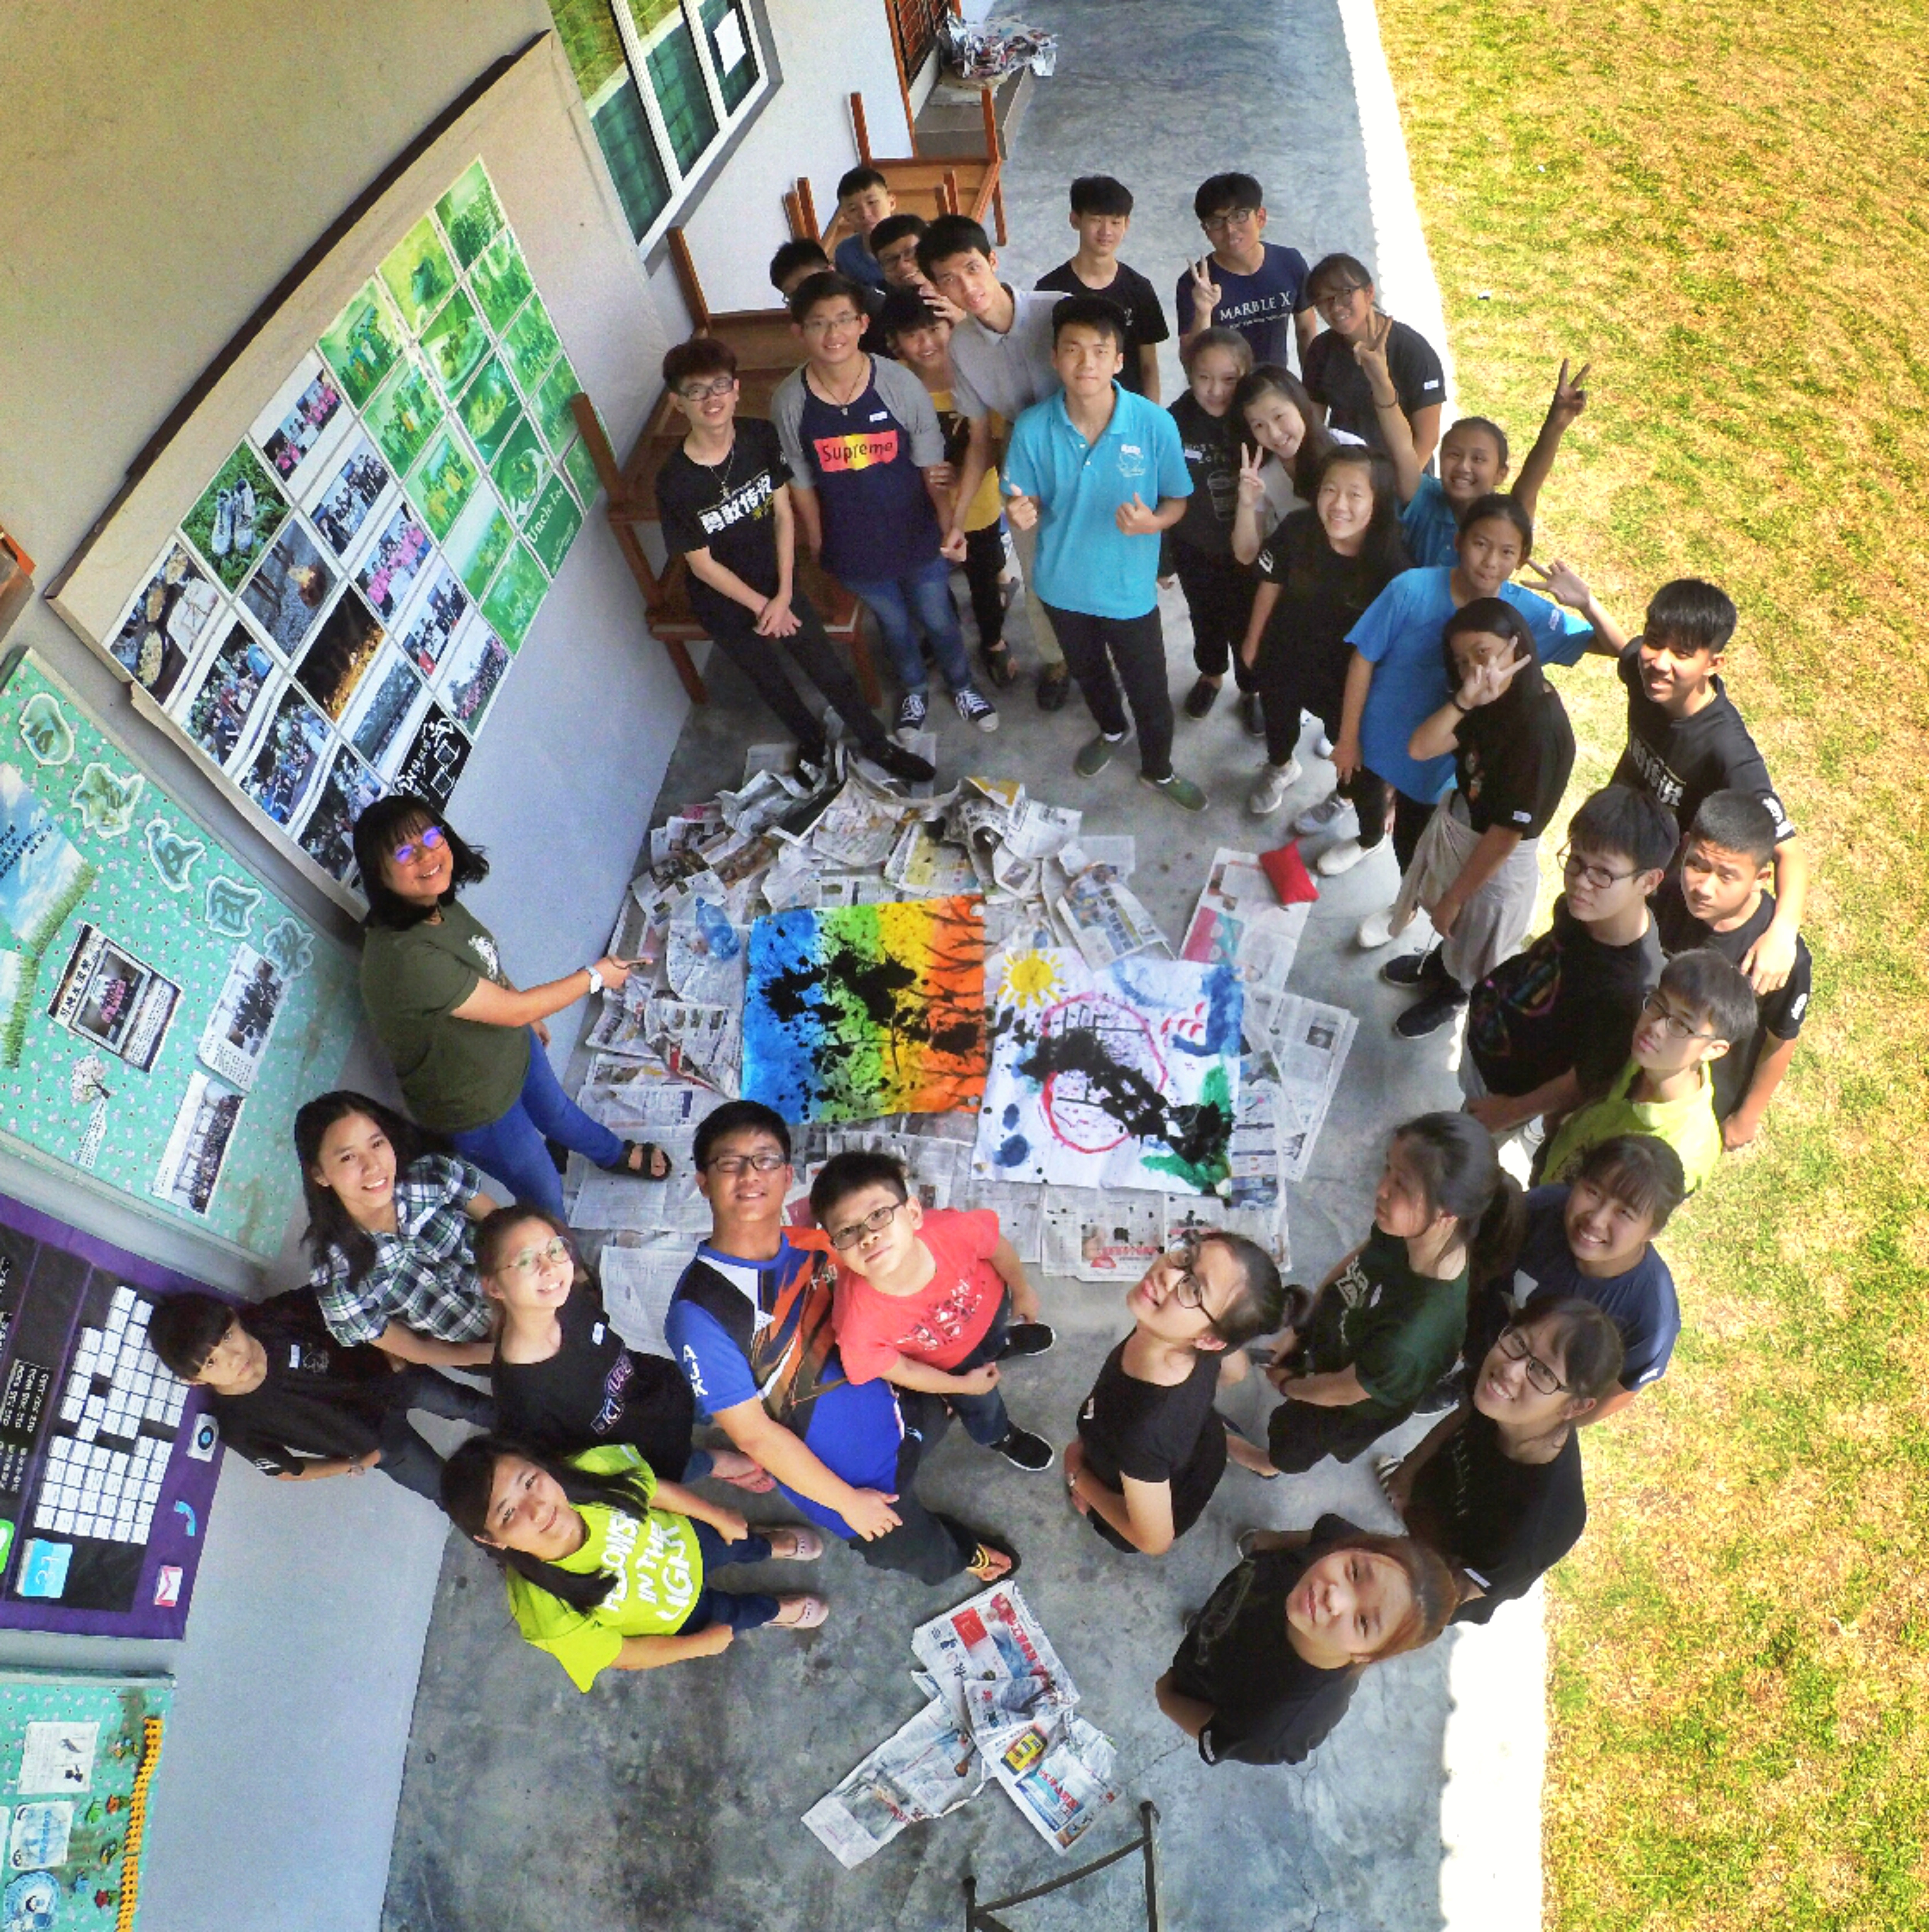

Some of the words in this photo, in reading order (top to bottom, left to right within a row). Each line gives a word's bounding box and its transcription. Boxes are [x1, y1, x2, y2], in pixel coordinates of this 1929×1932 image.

[1220, 296, 1276, 321] MARBLE
[1279, 290, 1291, 307] X
[822, 441, 893, 463] Supreme
